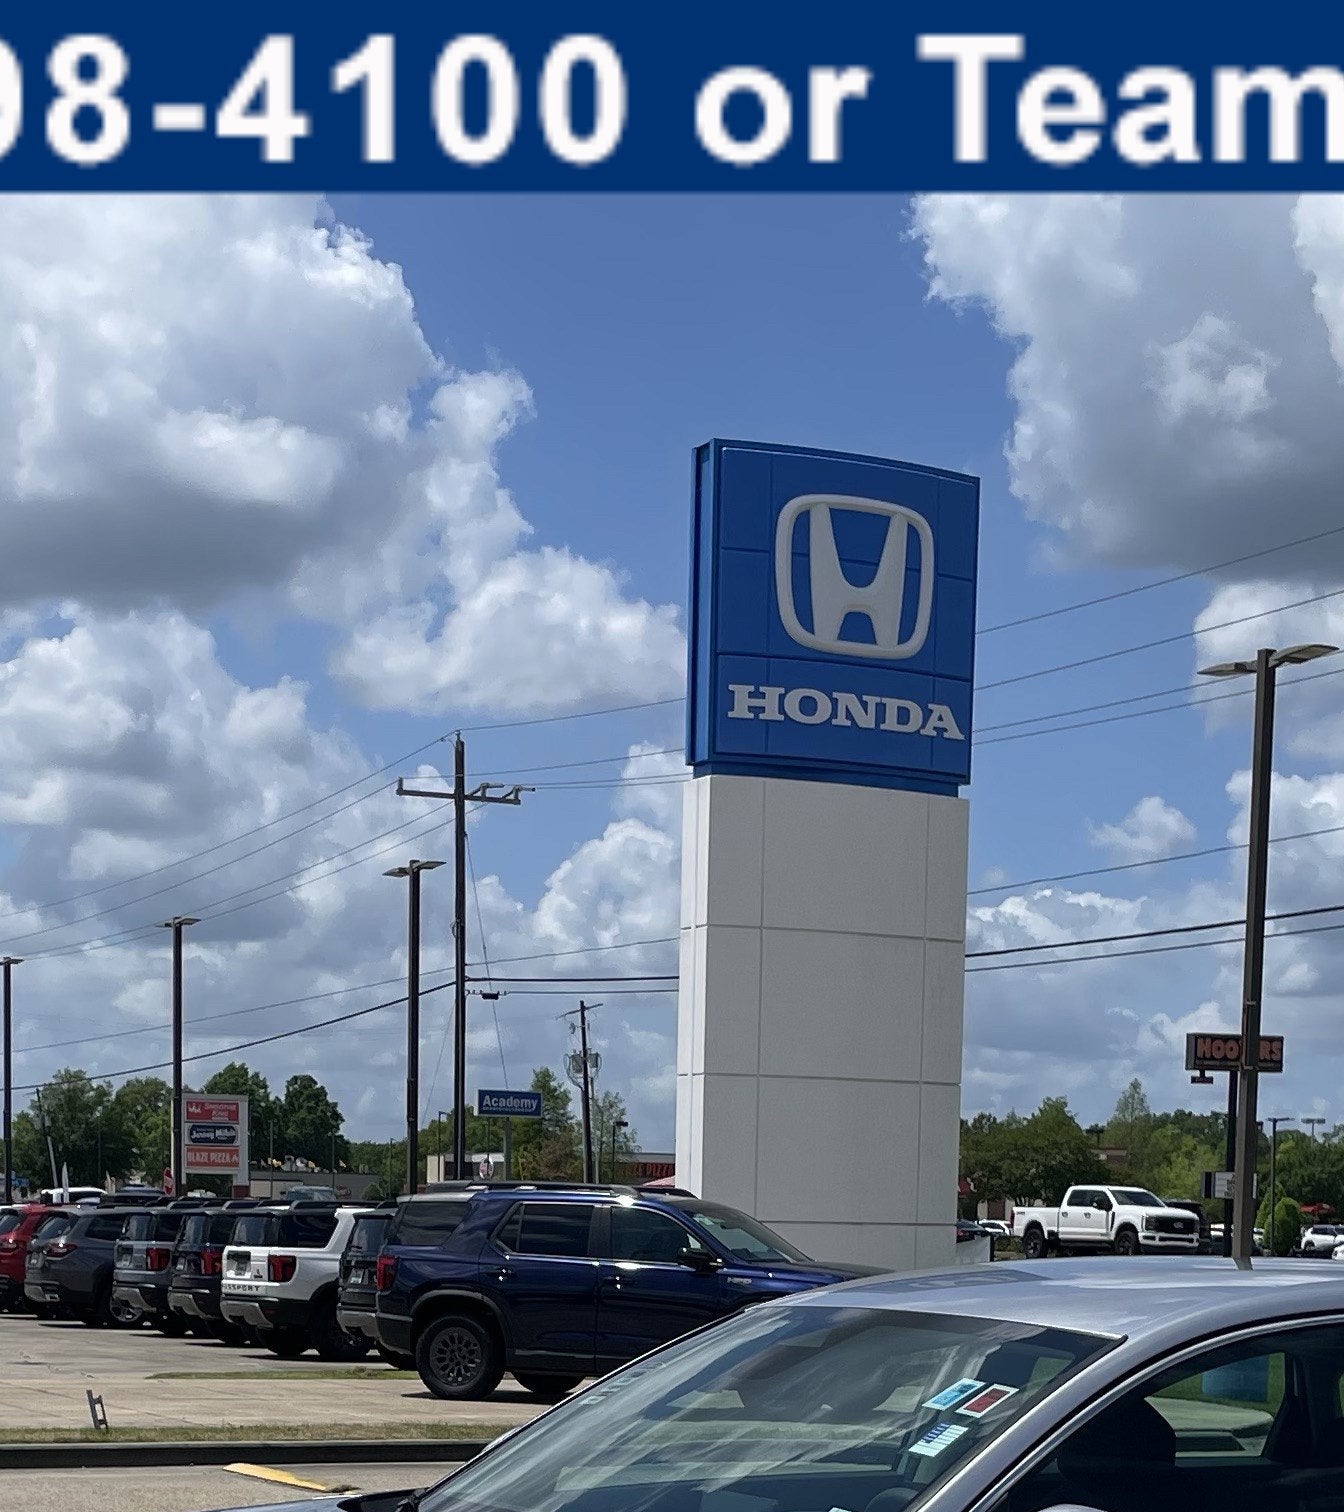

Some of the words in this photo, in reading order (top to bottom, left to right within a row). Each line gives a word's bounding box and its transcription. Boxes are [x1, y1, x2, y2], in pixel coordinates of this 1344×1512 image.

[727, 684, 965, 740] HONDA
[1196, 1038, 1282, 1060] HOORS
[483, 1095, 539, 1112] Academy
